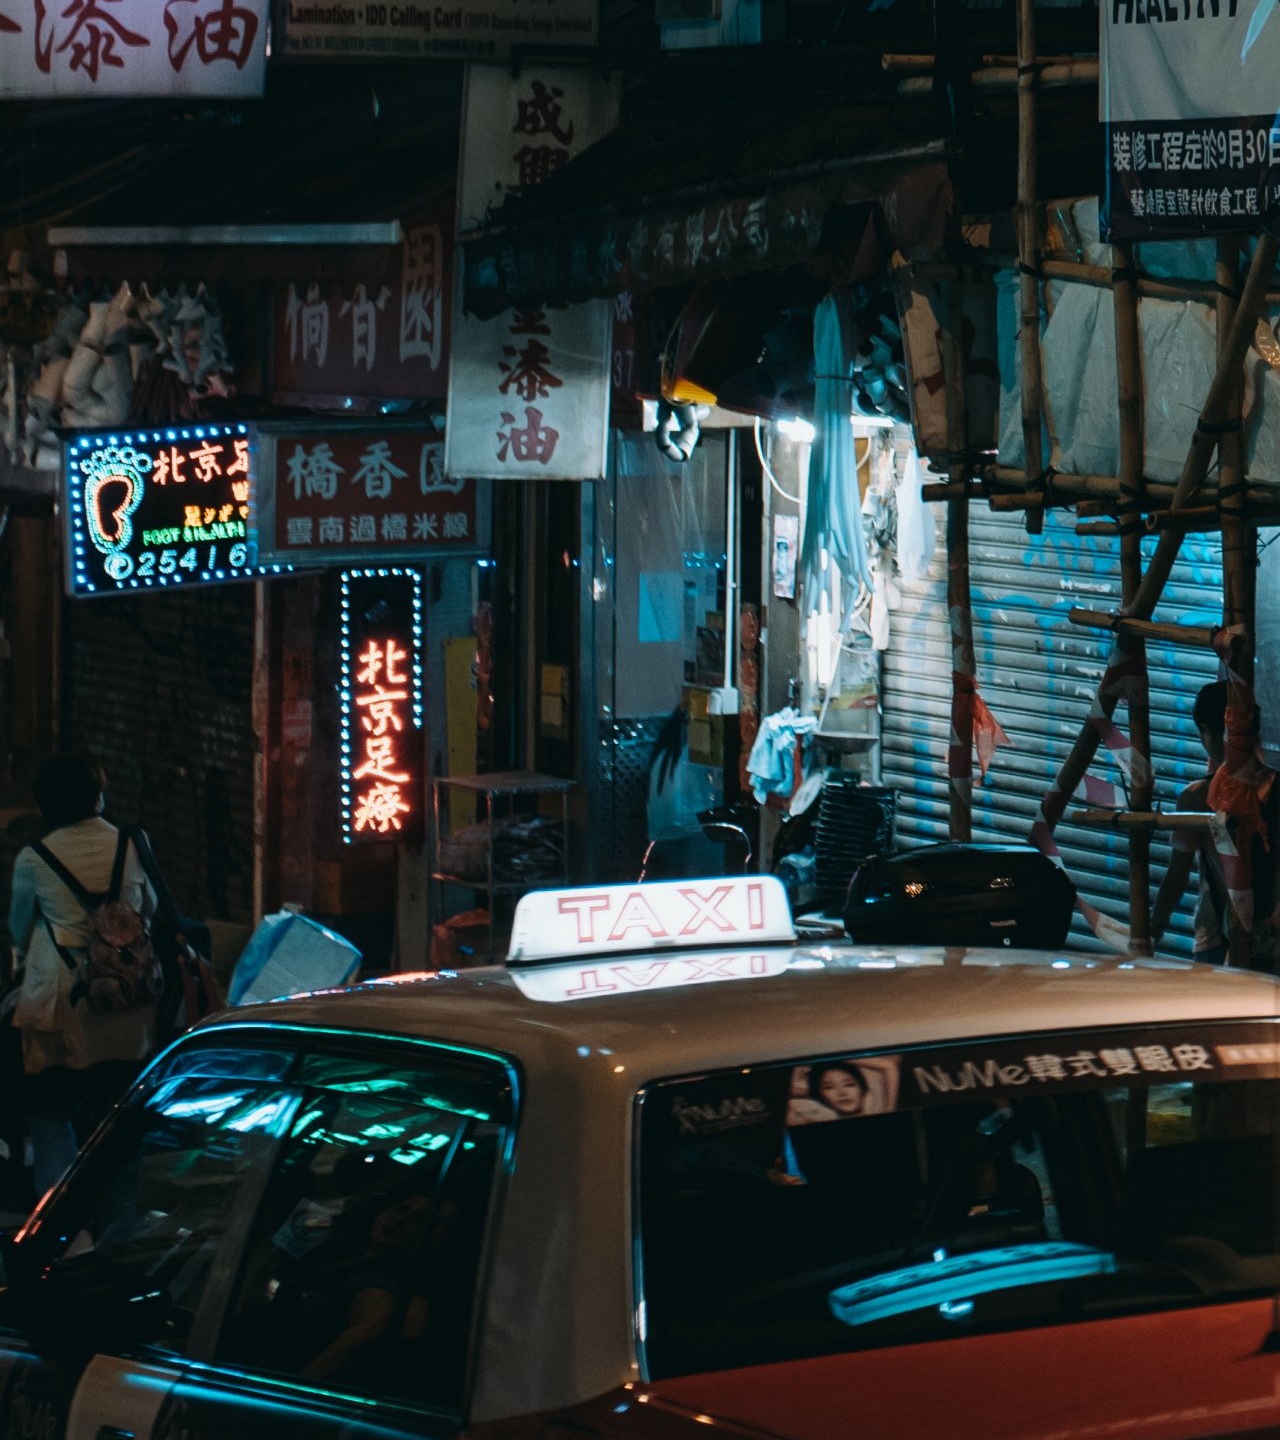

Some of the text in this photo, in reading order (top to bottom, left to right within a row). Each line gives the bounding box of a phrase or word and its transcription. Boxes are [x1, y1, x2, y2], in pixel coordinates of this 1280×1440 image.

[288, 4, 356, 26] Lamination
[390, 6, 431, 33] Calling
[286, 511, 470, 546] 雲南過橋米線
[353, 638, 411, 835] 北京足療
[556, 882, 766, 945] TAXI
